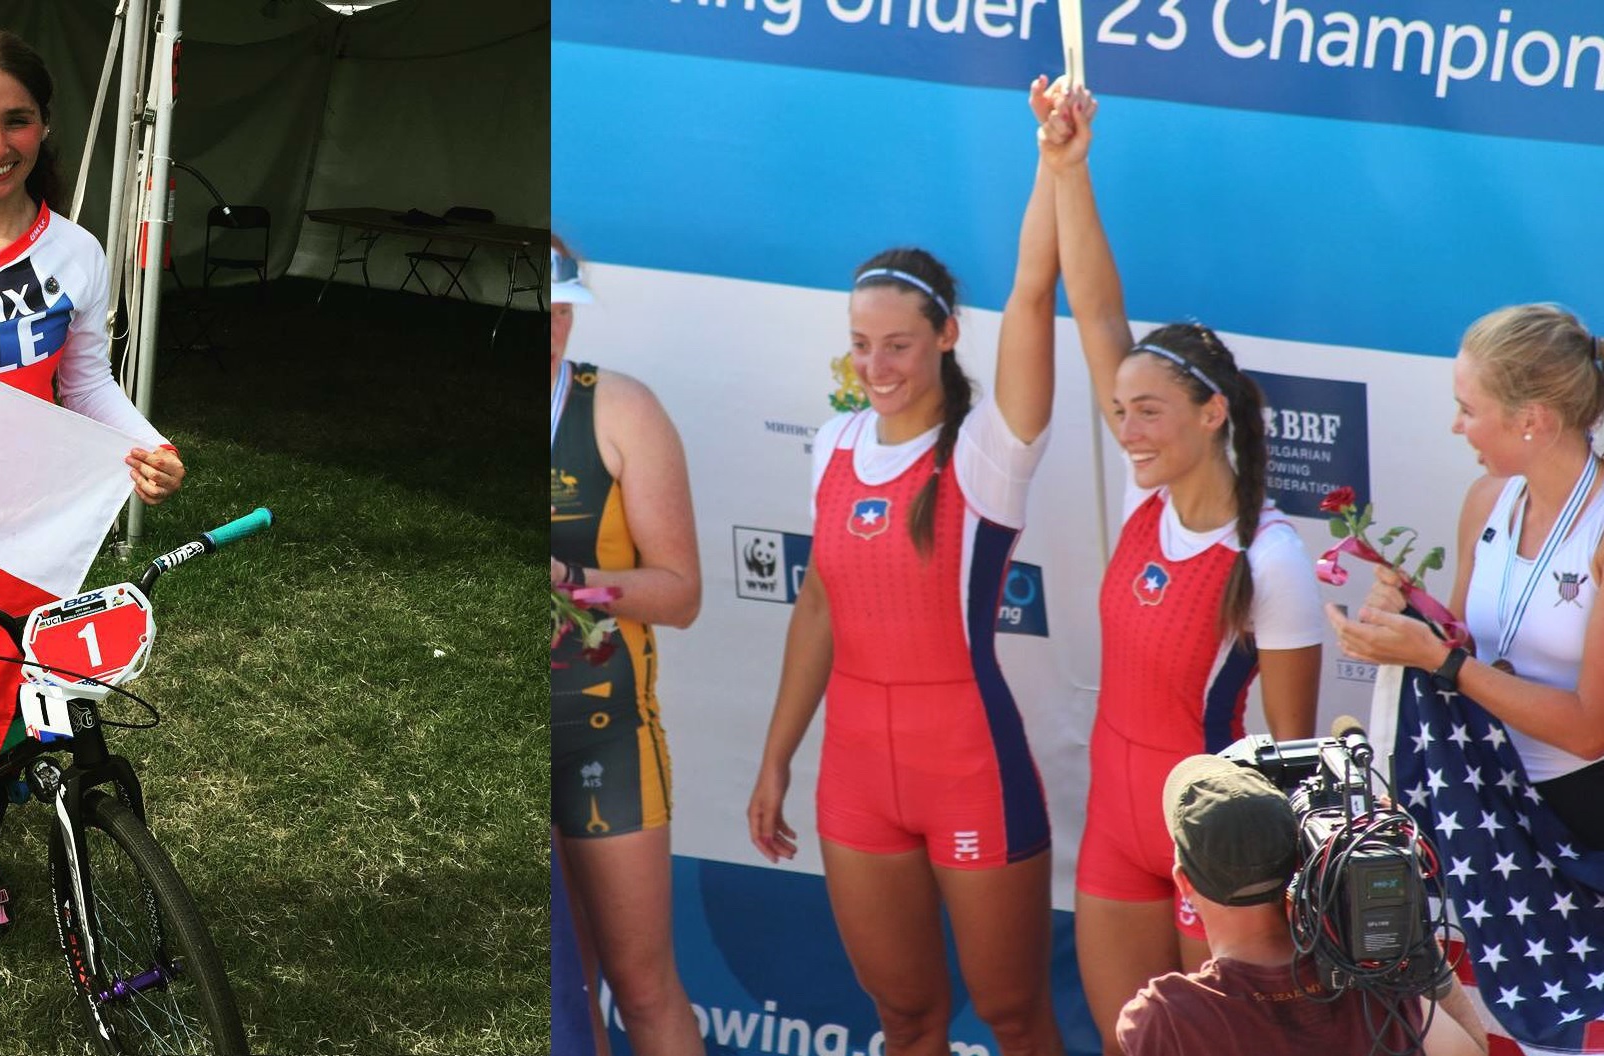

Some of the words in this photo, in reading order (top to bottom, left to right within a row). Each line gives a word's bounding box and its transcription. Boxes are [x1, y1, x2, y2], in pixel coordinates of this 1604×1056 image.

[1097, 0, 1188, 50] 23
[1280, 409, 1341, 444] BRF
[1267, 445, 1331, 462] ULGARIAN
[1267, 461, 1311, 476] OWING
[1267, 476, 1340, 495] EDERATION
[746, 580, 777, 593] WWF
[63, 591, 104, 609] BOX
[45, 617, 61, 626] UCI
[77, 622, 103, 668] 1
[36, 692, 50, 726] 1
